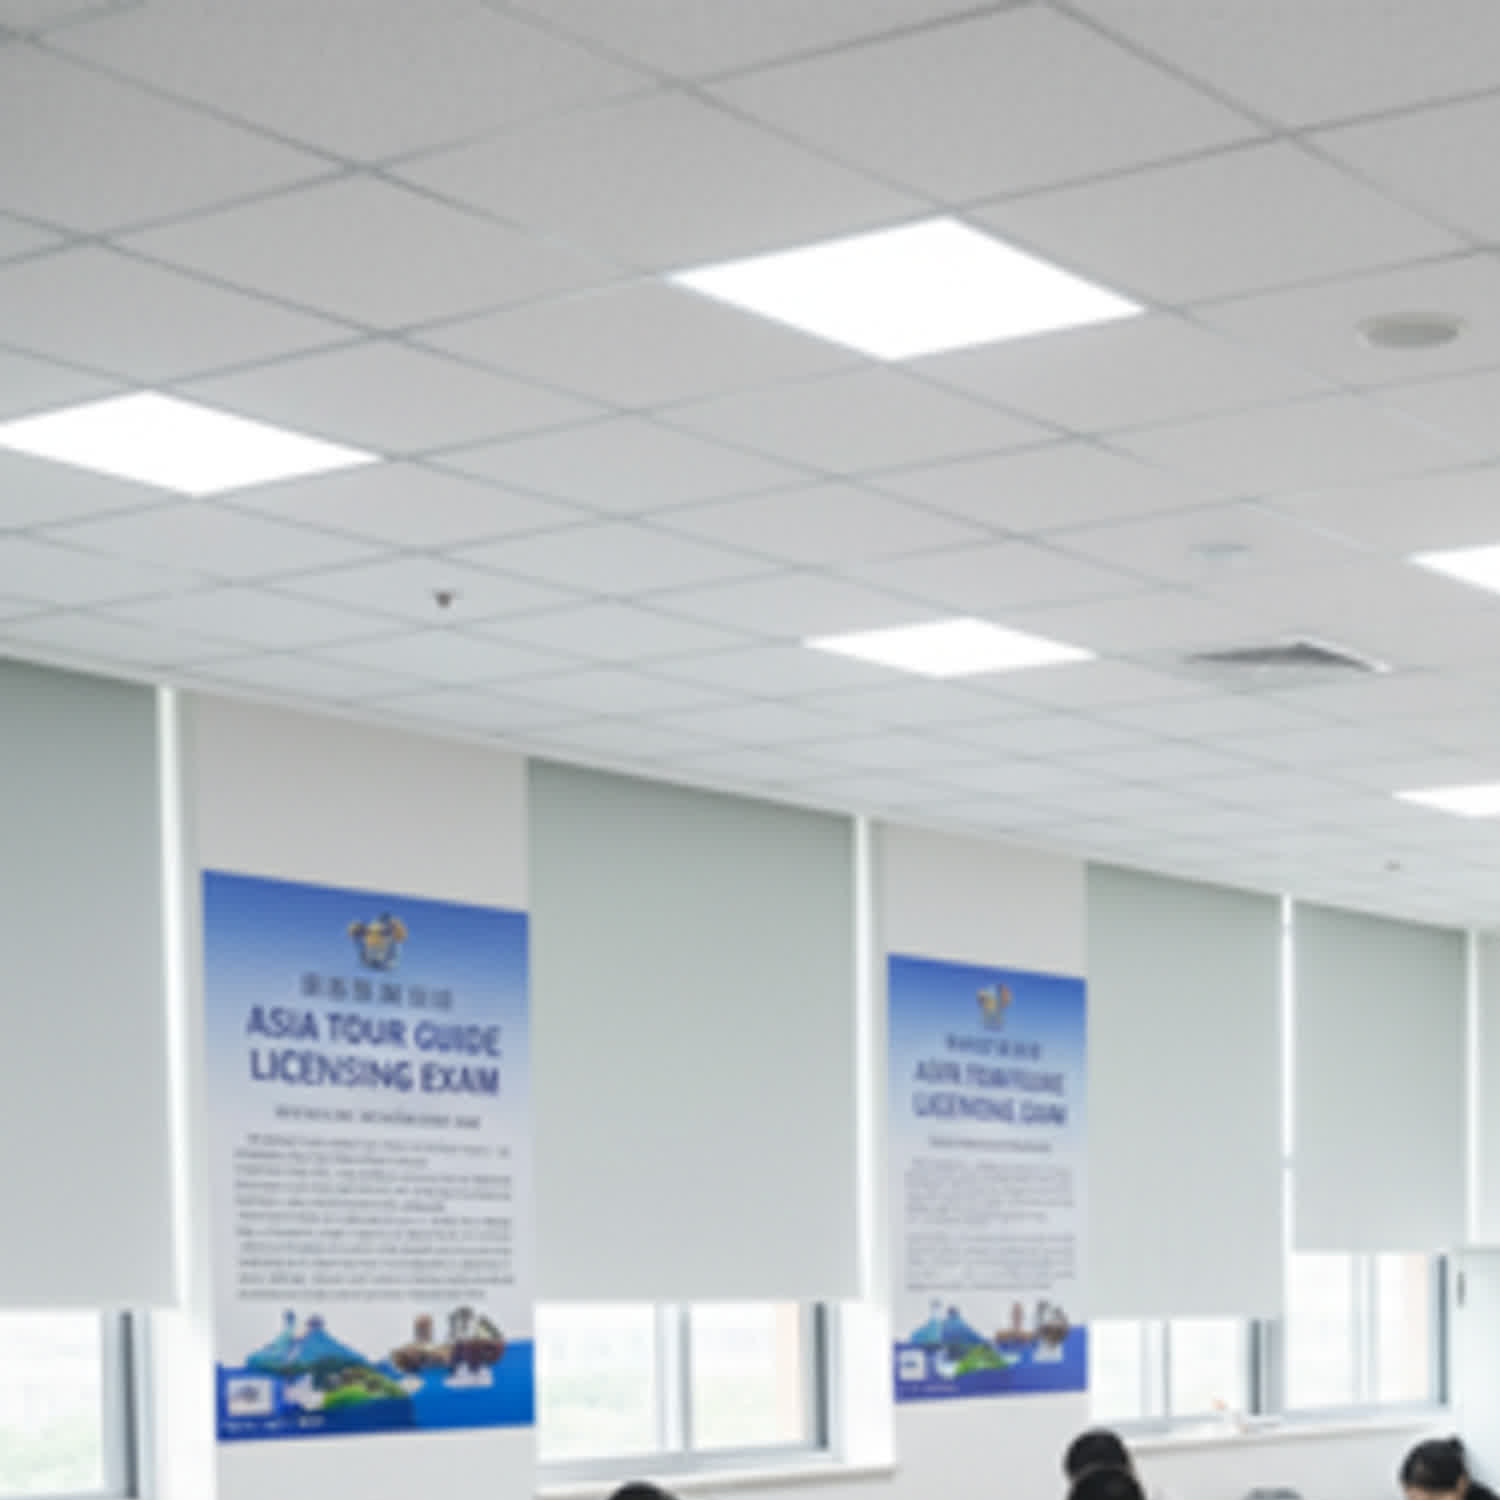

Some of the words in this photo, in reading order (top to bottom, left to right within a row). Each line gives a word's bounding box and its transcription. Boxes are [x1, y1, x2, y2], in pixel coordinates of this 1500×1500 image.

[247, 1007, 319, 1042] ASIA
[324, 1011, 407, 1048] TOUR
[413, 1018, 502, 1057] GUIDE
[419, 1062, 499, 1096] EXAM
